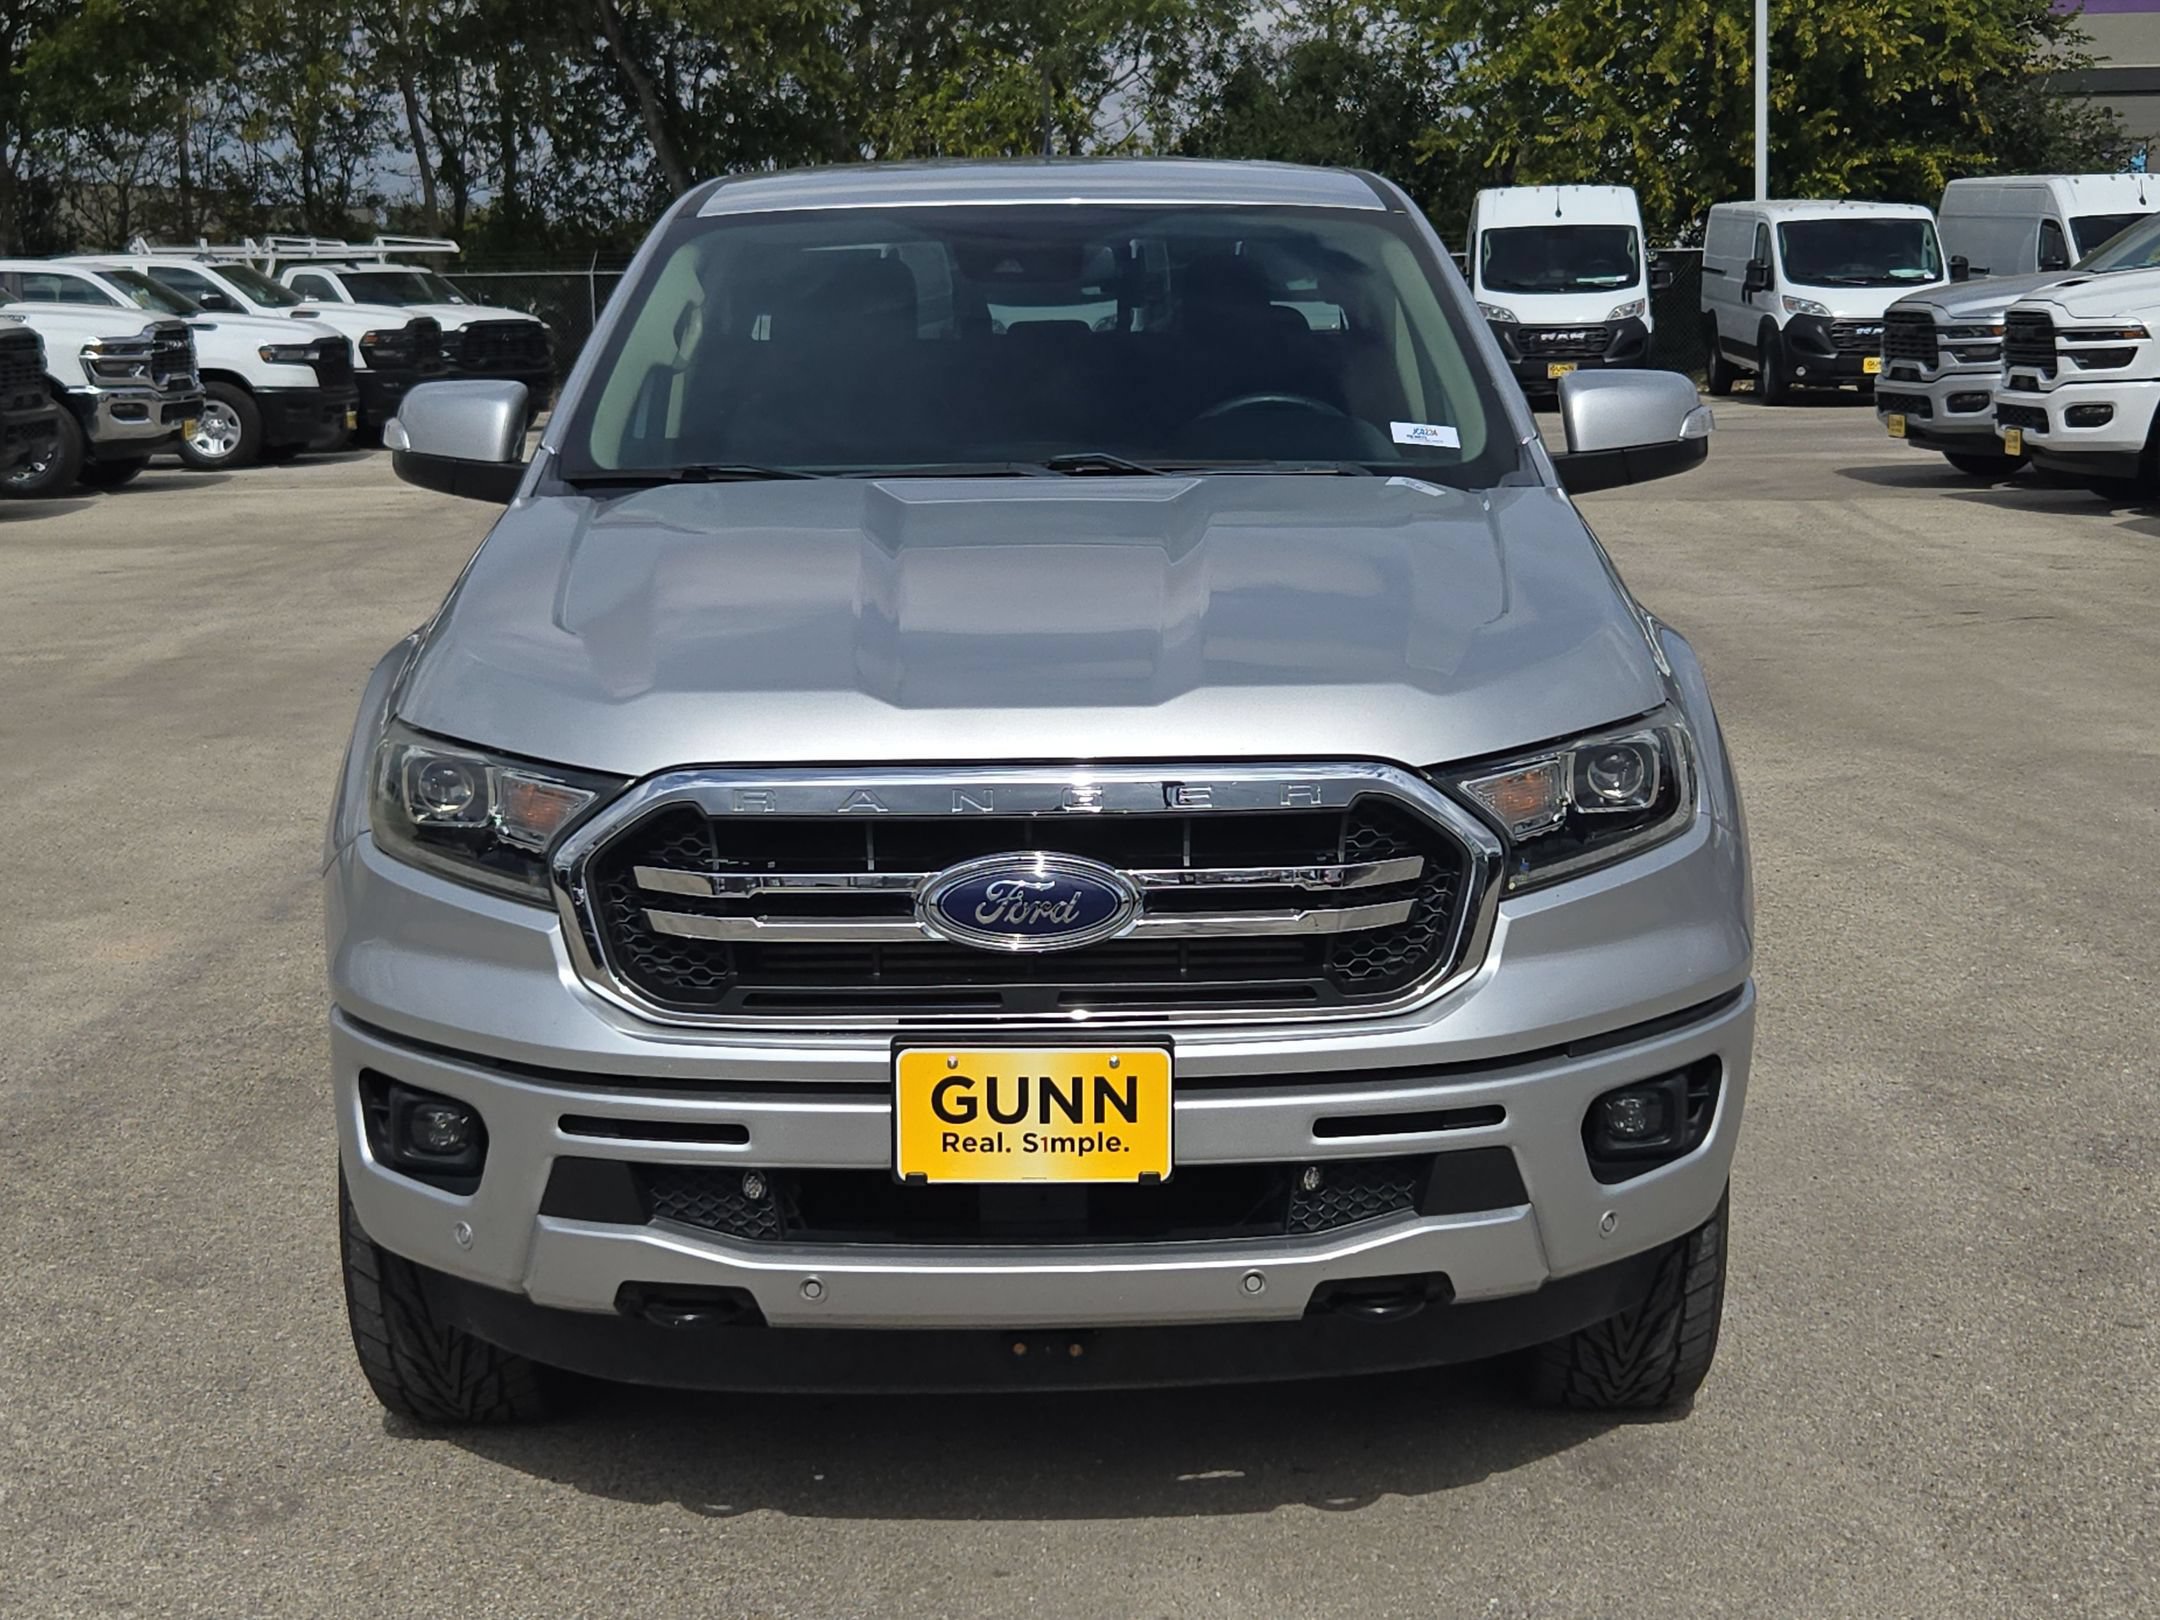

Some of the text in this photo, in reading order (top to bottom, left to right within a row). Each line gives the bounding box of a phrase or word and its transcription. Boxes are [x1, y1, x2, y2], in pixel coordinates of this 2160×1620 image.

[733, 782, 1322, 812] RANGER
[975, 880, 1082, 924] Ford
[931, 1075, 1138, 1125] GUNN
[941, 1131, 1012, 1153] Real.
